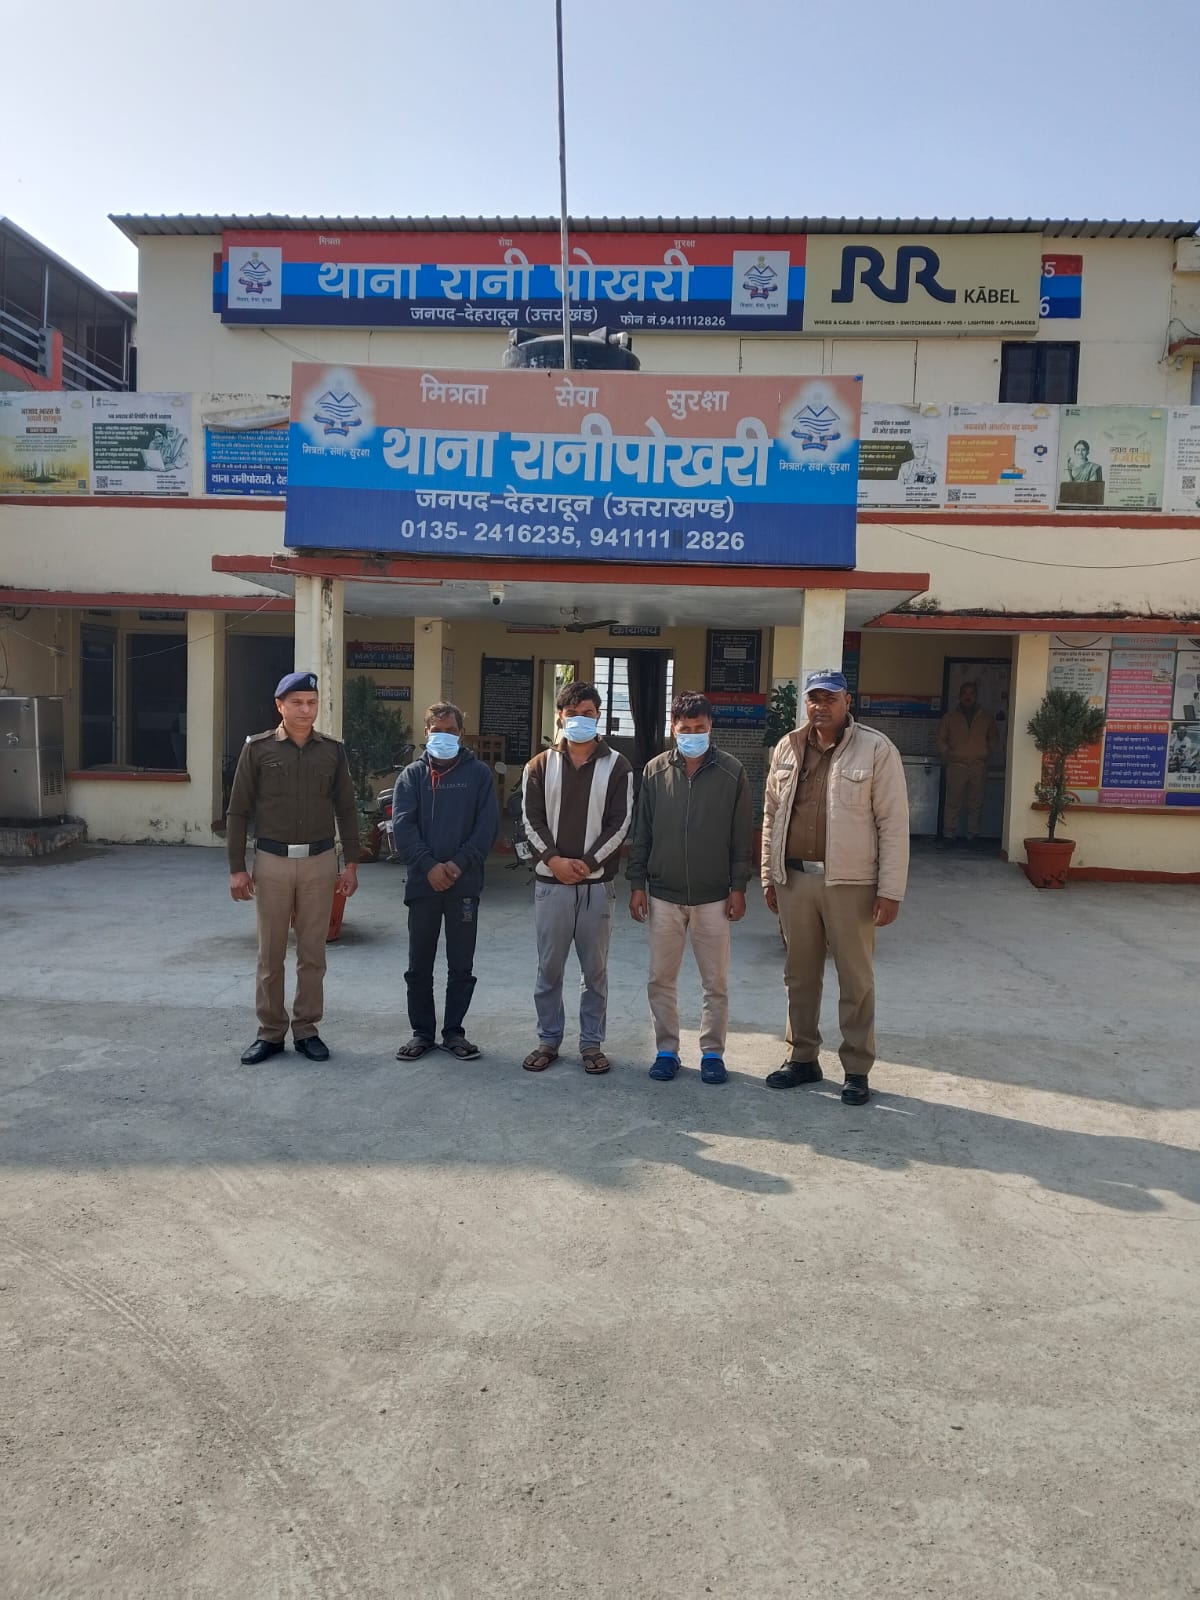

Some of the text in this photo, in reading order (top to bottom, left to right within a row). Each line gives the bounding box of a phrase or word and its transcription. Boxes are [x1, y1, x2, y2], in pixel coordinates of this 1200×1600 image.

[673, 239, 696, 249] सुरक्षा
[318, 247, 695, 303] थाना रानी पोखरी
[831, 245, 957, 303] RR
[964, 286, 1020, 304] KĀBEL
[410, 303, 598, 326] जनपद-देहरादून (उत्तरखंड)
[620, 312, 643, 326] फोन
[420, 374, 489, 405] मित्रता
[555, 378, 599, 408] सेवा
[666, 388, 730, 420] सुरक्षा
[349, 447, 371, 460] सुरक्षा
[383, 413, 774, 488] थाना रानीपोखरी
[211, 473, 230, 483] थाना
[828, 462, 851, 475] सुरक्षा
[415, 485, 735, 523] जनपद-देहरादून (उत्तराखण्ड)
[401, 519, 745, 551] 0135- 2416235, 941111 2826
